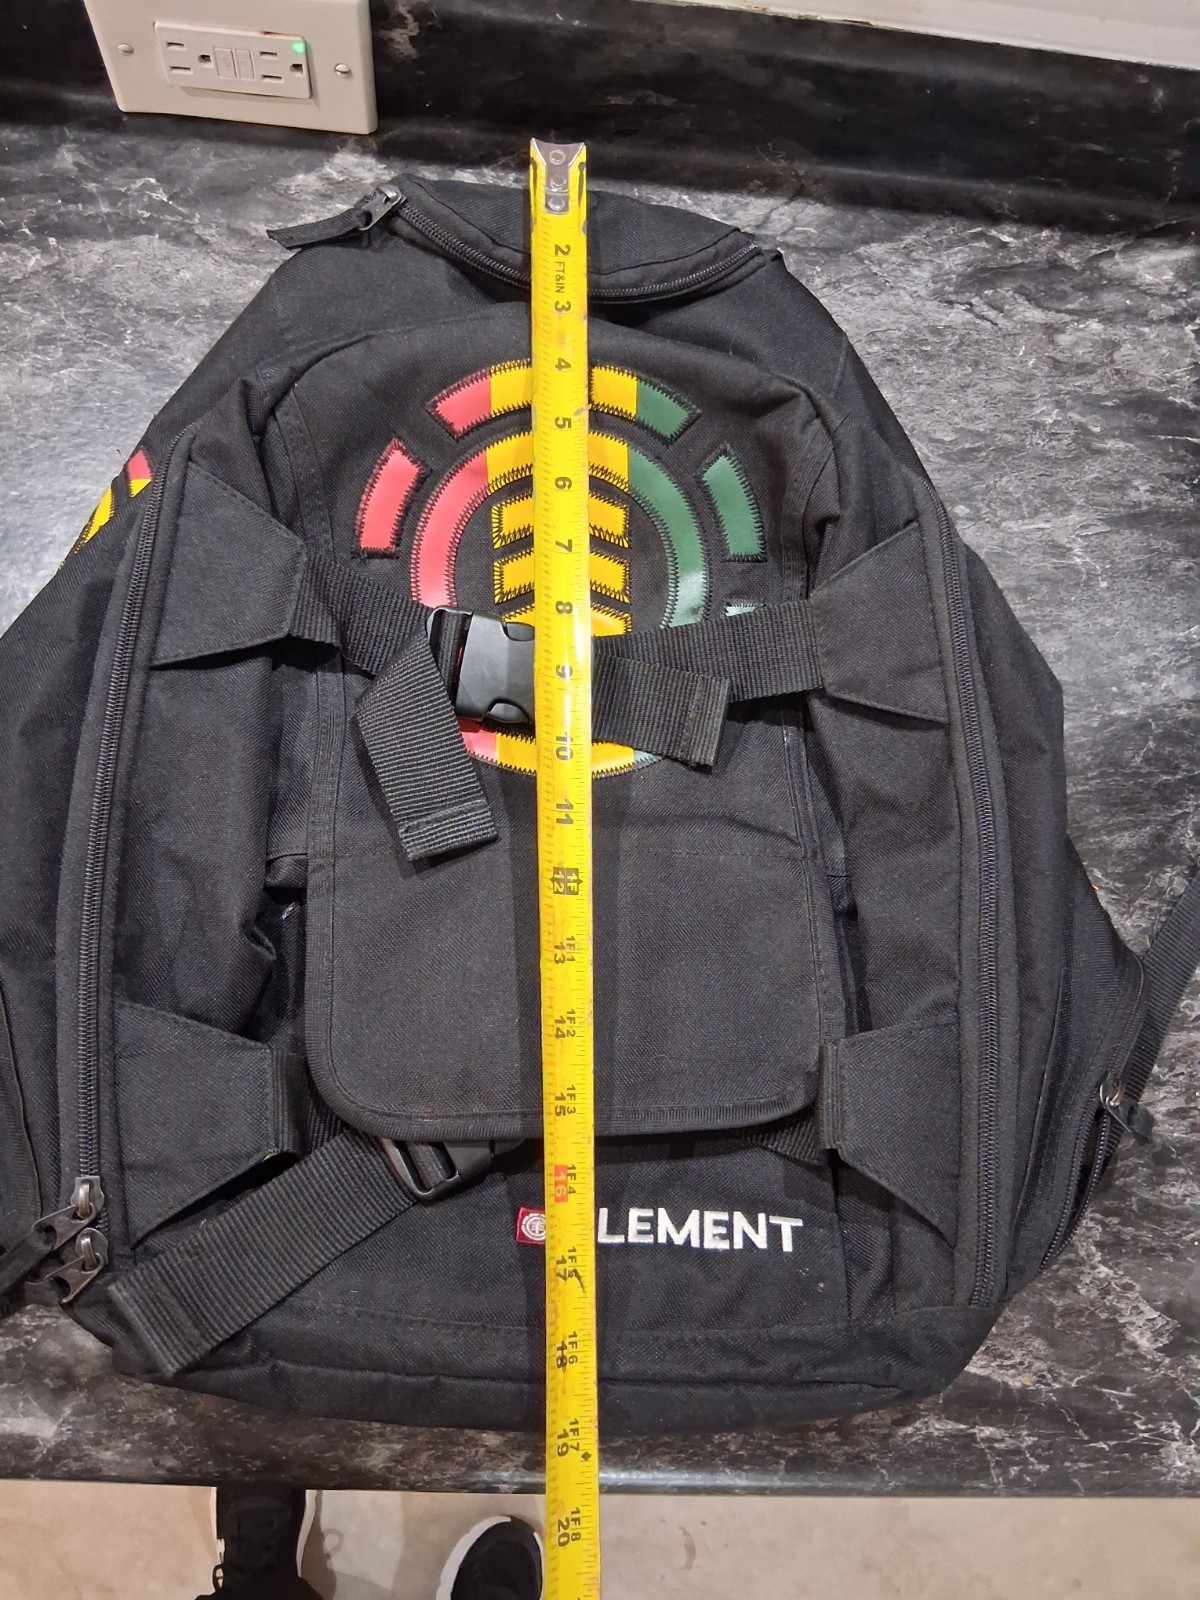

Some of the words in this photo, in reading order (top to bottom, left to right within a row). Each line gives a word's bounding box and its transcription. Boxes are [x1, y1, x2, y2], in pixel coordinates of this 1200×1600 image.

[554, 244, 571, 256] 2
[554, 261, 566, 294] FT&IN
[554, 300, 571, 313] 3
[554, 357, 572, 371] 4
[554, 416, 572, 429] 5
[554, 476, 572, 490] 6
[555, 538, 573, 553] 7
[555, 600, 573, 615] 8
[555, 664, 573, 679] 9
[556, 731, 574, 761] 10
[556, 799, 574, 825] 11
[553, 871, 565, 893] 12
[554, 942, 566, 964] 13
[554, 1016, 566, 1039] 14
[554, 1092, 566, 1117] 15
[555, 1171, 567, 1197] 16
[597, 1207, 804, 1252] LEMENT
[556, 1255, 568, 1282] 17
[556, 1340, 568, 1369] 18
[557, 1428, 569, 1457] 19
[557, 1519, 570, 1547] 20
